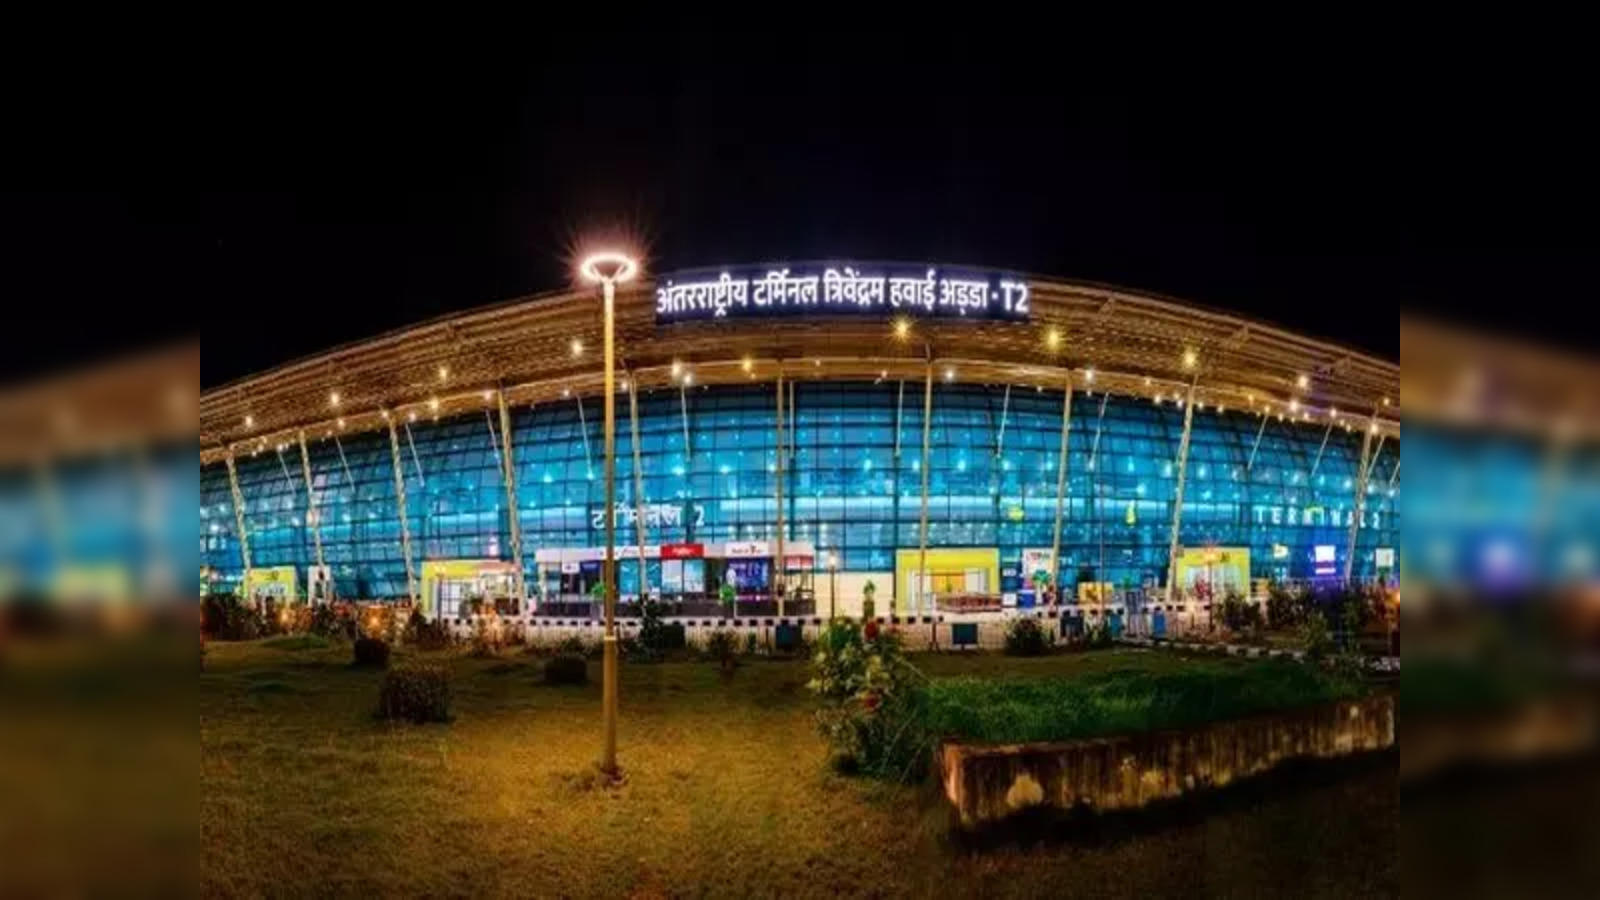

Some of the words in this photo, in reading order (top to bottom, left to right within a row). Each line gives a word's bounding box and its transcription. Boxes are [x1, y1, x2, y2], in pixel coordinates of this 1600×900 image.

[752, 269, 819, 306] टर्मिनल
[823, 267, 885, 307] त्रिवेंद्रम
[889, 268, 936, 311] हवाई
[1000, 281, 1029, 313] T2
